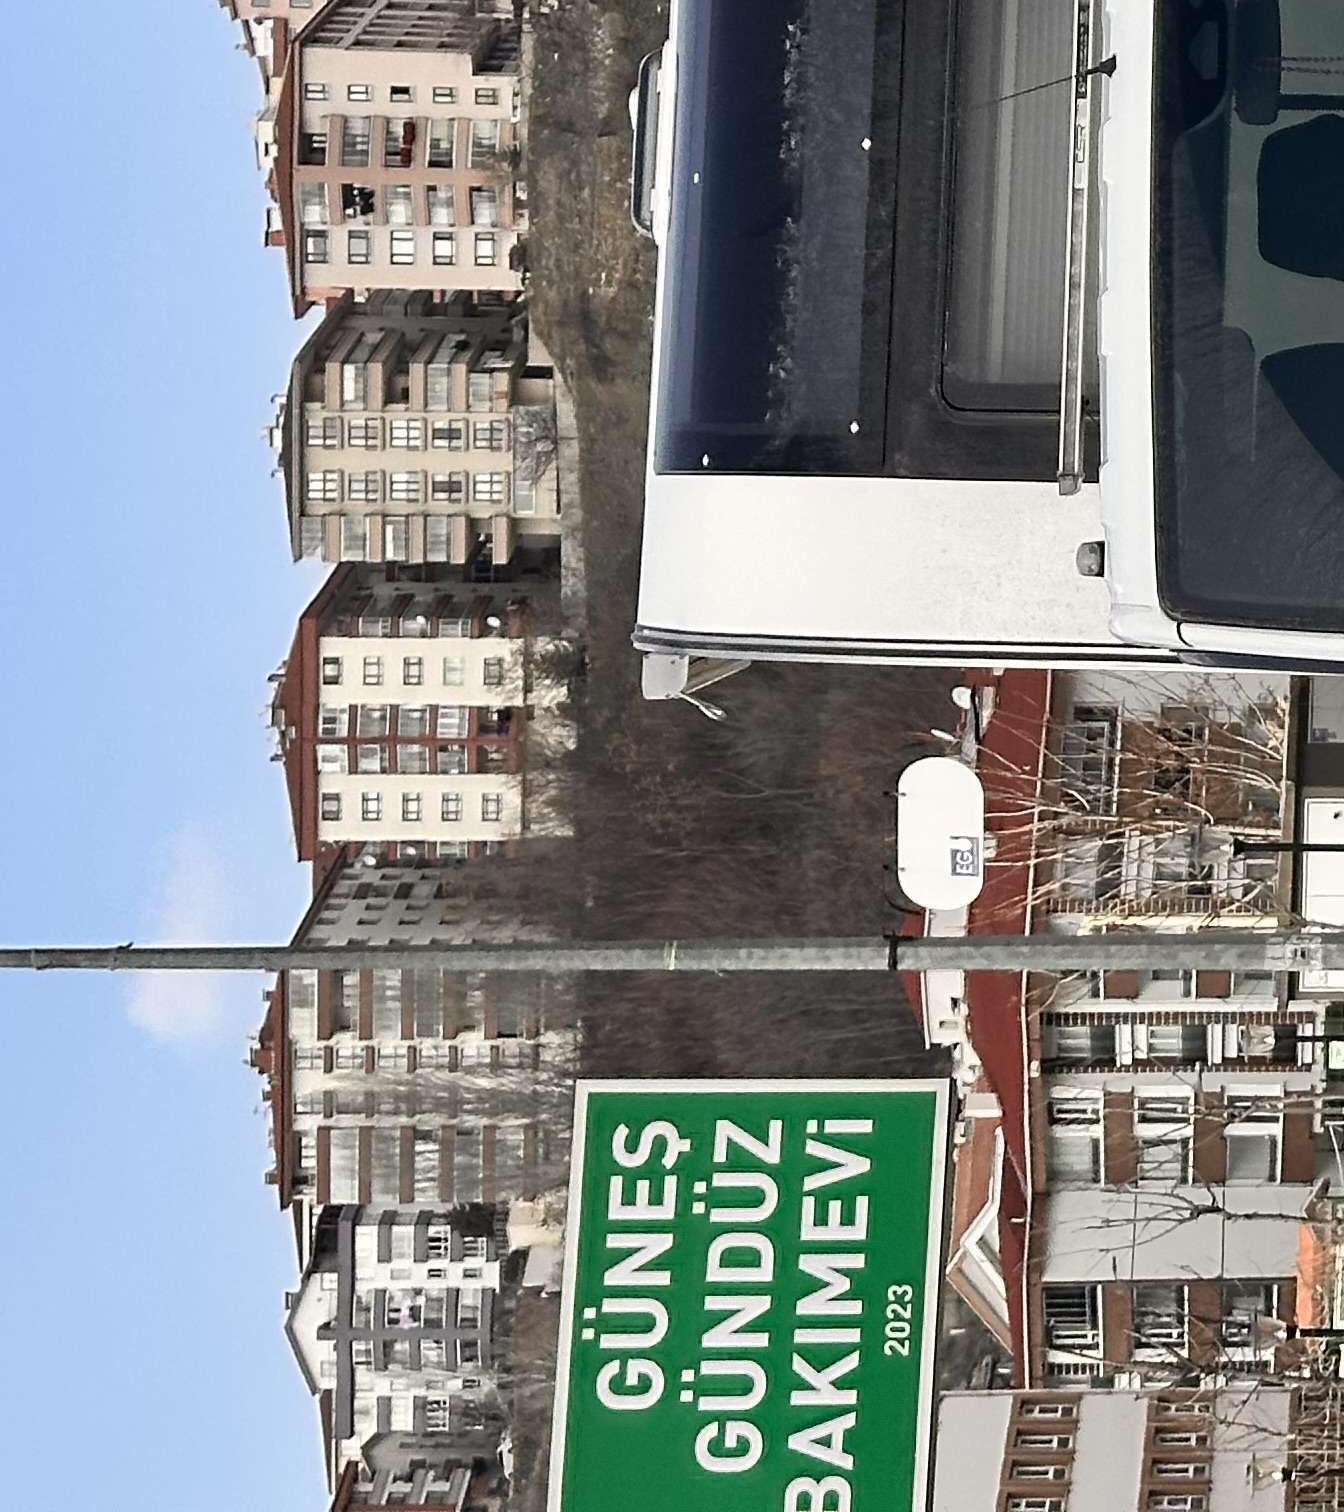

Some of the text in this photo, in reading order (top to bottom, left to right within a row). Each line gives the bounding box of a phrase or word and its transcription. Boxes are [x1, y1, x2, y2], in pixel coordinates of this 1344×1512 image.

[582, 1120, 691, 1410] GÜNEŞ
[680, 1119, 783, 1473] GÜNDÜZ
[884, 1284, 913, 1357] 2023
